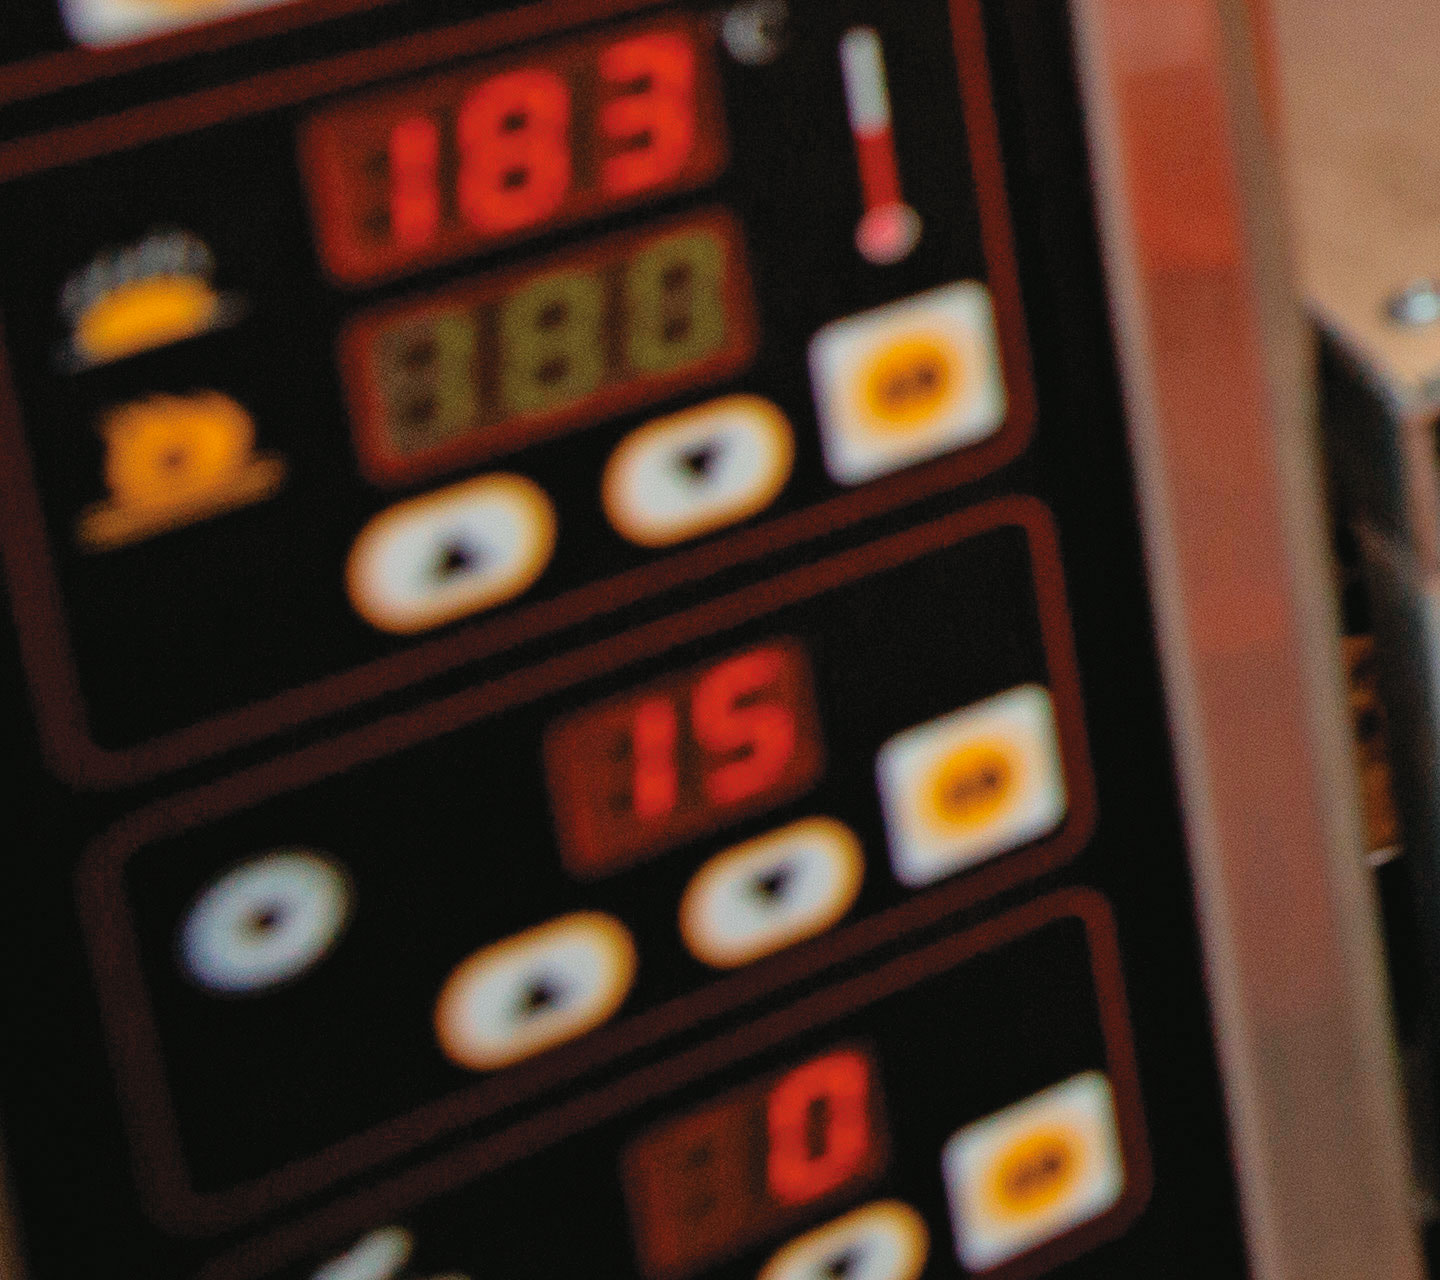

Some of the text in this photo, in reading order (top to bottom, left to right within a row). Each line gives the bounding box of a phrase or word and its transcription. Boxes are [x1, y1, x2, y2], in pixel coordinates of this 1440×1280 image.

[387, 28, 697, 246] 183
[631, 643, 797, 820] 15
[765, 1046, 871, 1208] 0
